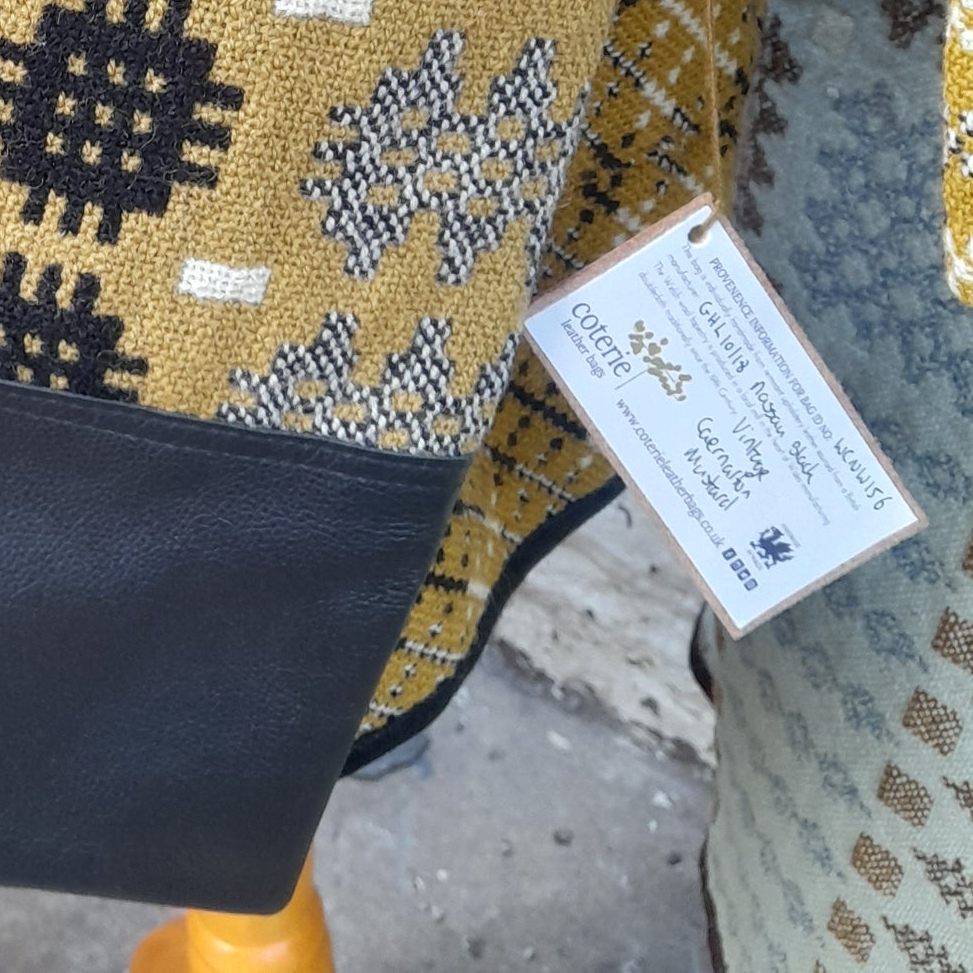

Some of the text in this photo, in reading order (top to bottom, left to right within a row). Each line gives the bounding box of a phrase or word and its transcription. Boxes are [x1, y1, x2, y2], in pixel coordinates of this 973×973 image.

[560, 318, 606, 379] leather bags
[572, 302, 631, 377] coterie
[748, 317, 793, 379] INFORMATION
[787, 377, 806, 398] FOR
[799, 395, 818, 416] BAG
[617, 399, 724, 548] www.coterieleatherbags.co.uk
[684, 448, 739, 511] Mustard
